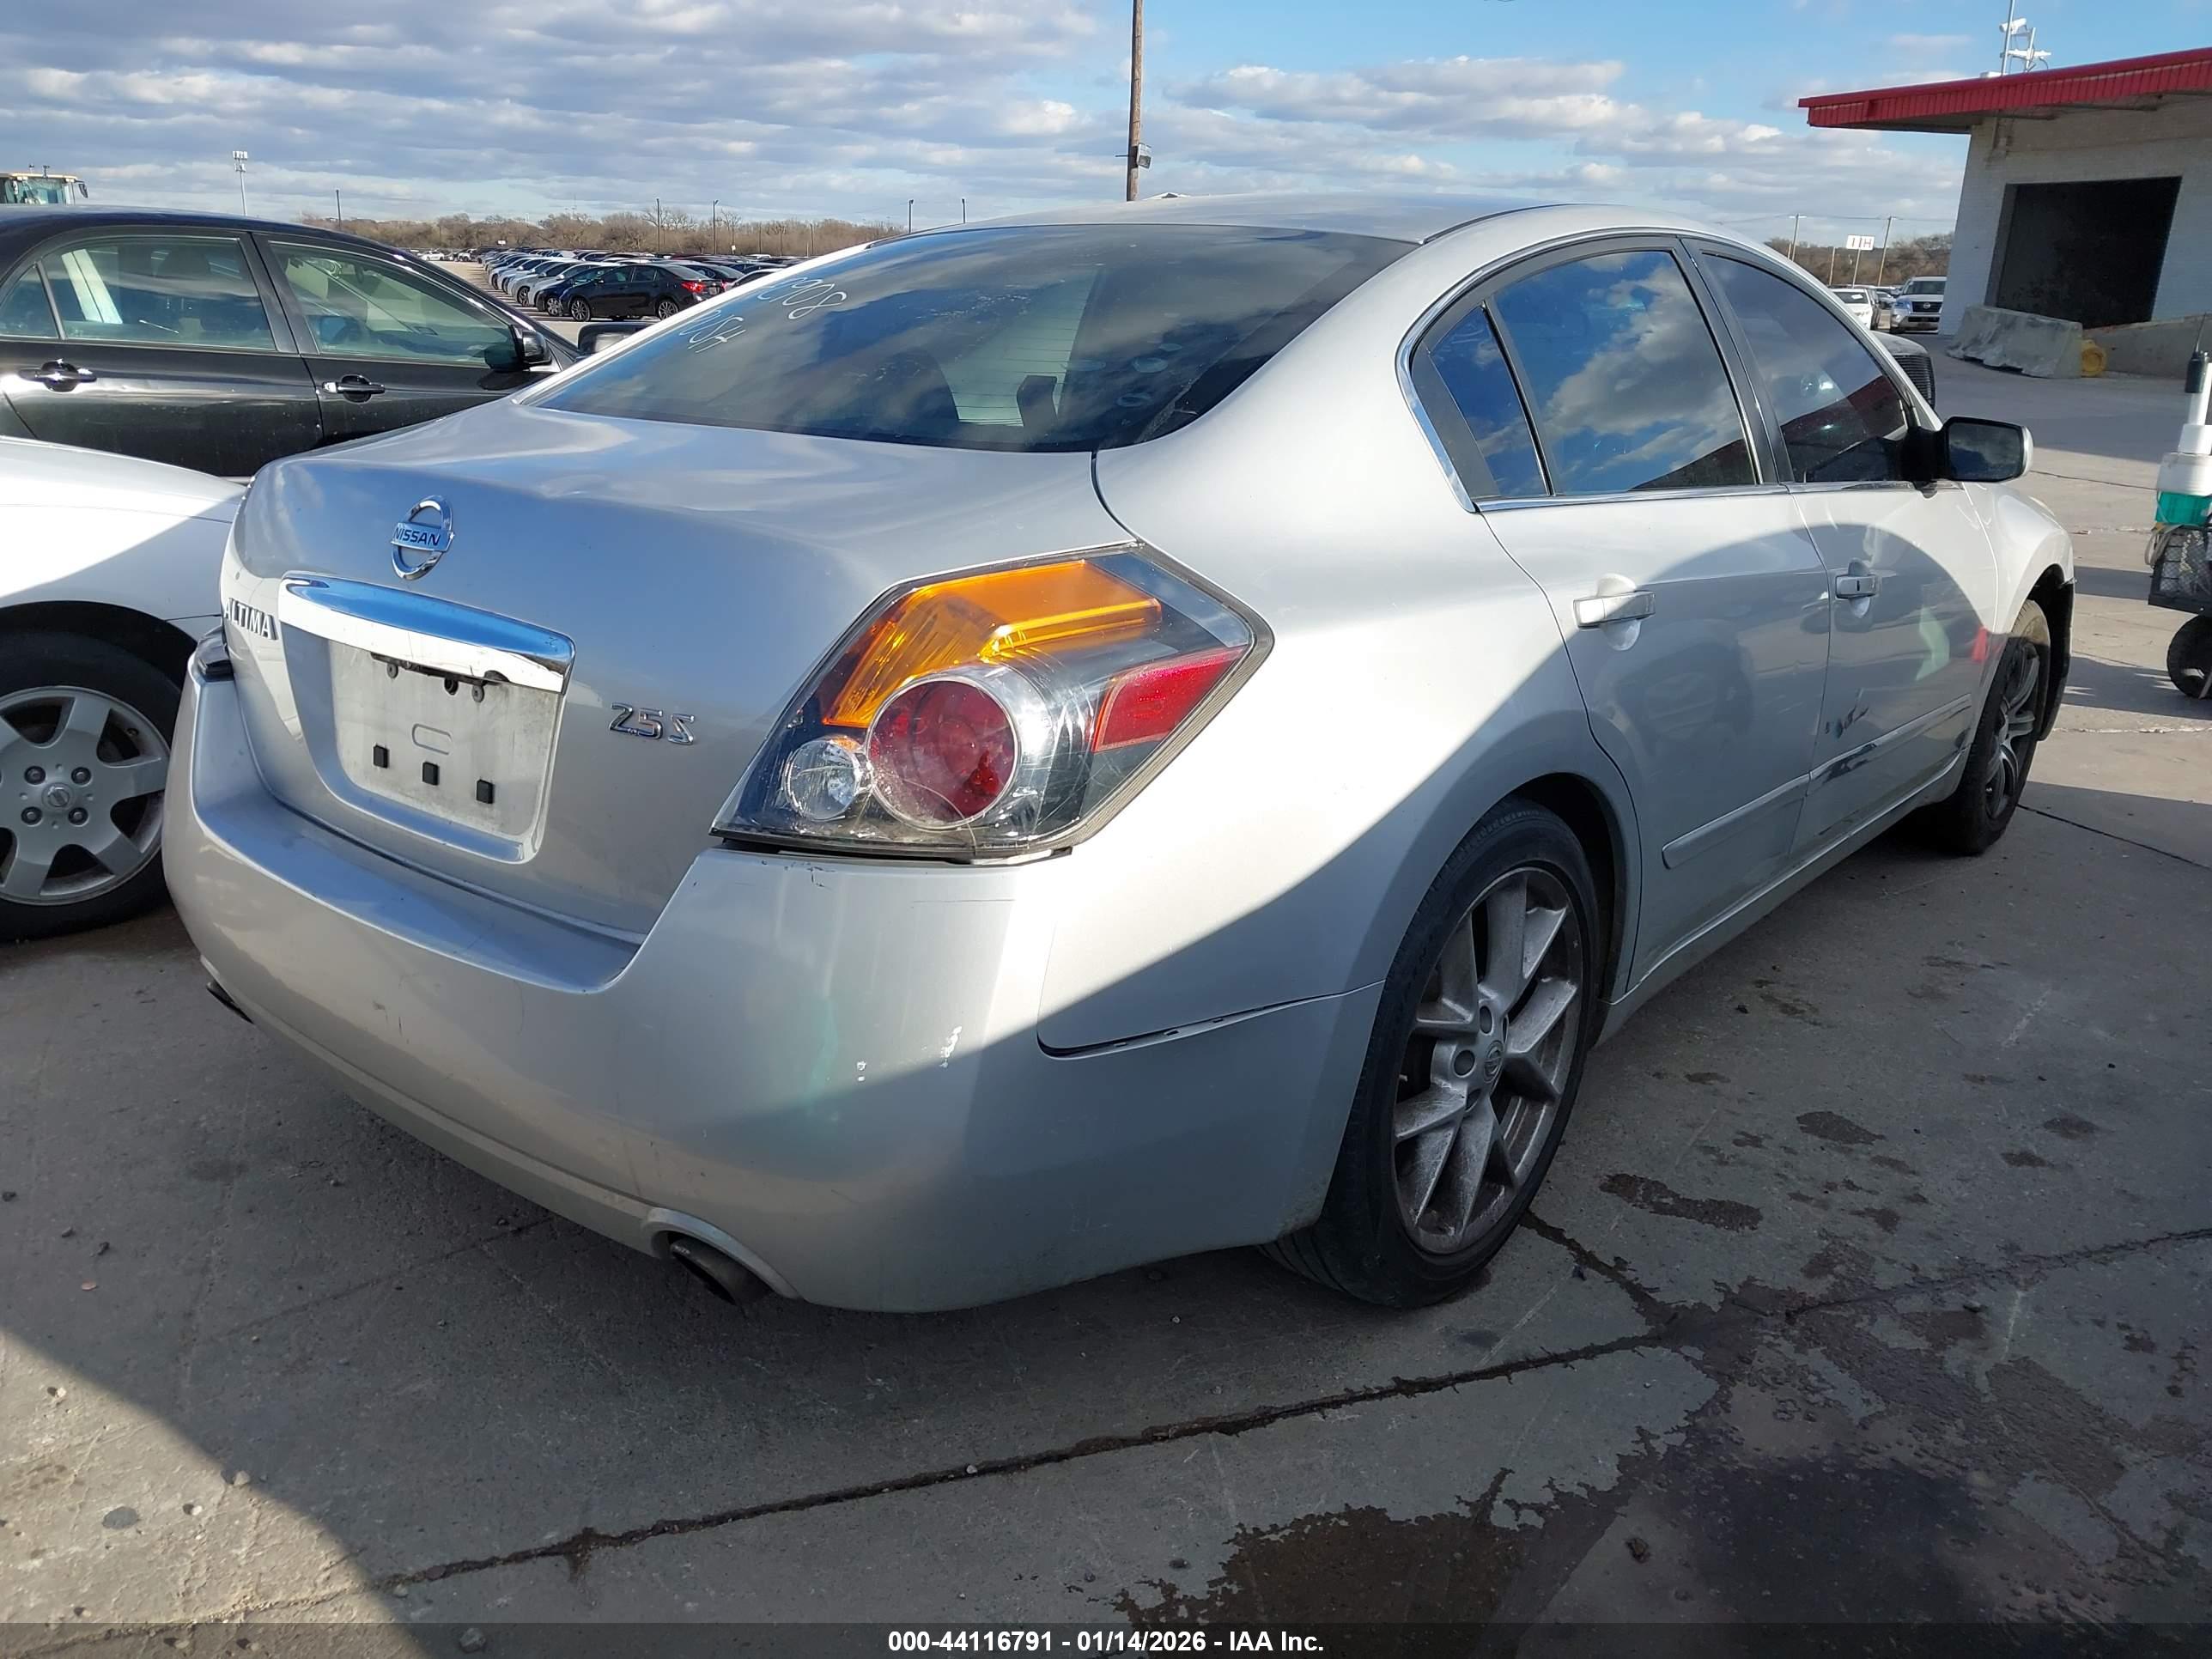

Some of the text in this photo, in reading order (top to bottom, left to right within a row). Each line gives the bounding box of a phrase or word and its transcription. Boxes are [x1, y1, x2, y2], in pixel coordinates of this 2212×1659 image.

[393, 527, 441, 546] NISSAN
[223, 597, 276, 641] ALTIMA
[667, 713, 695, 745] S
